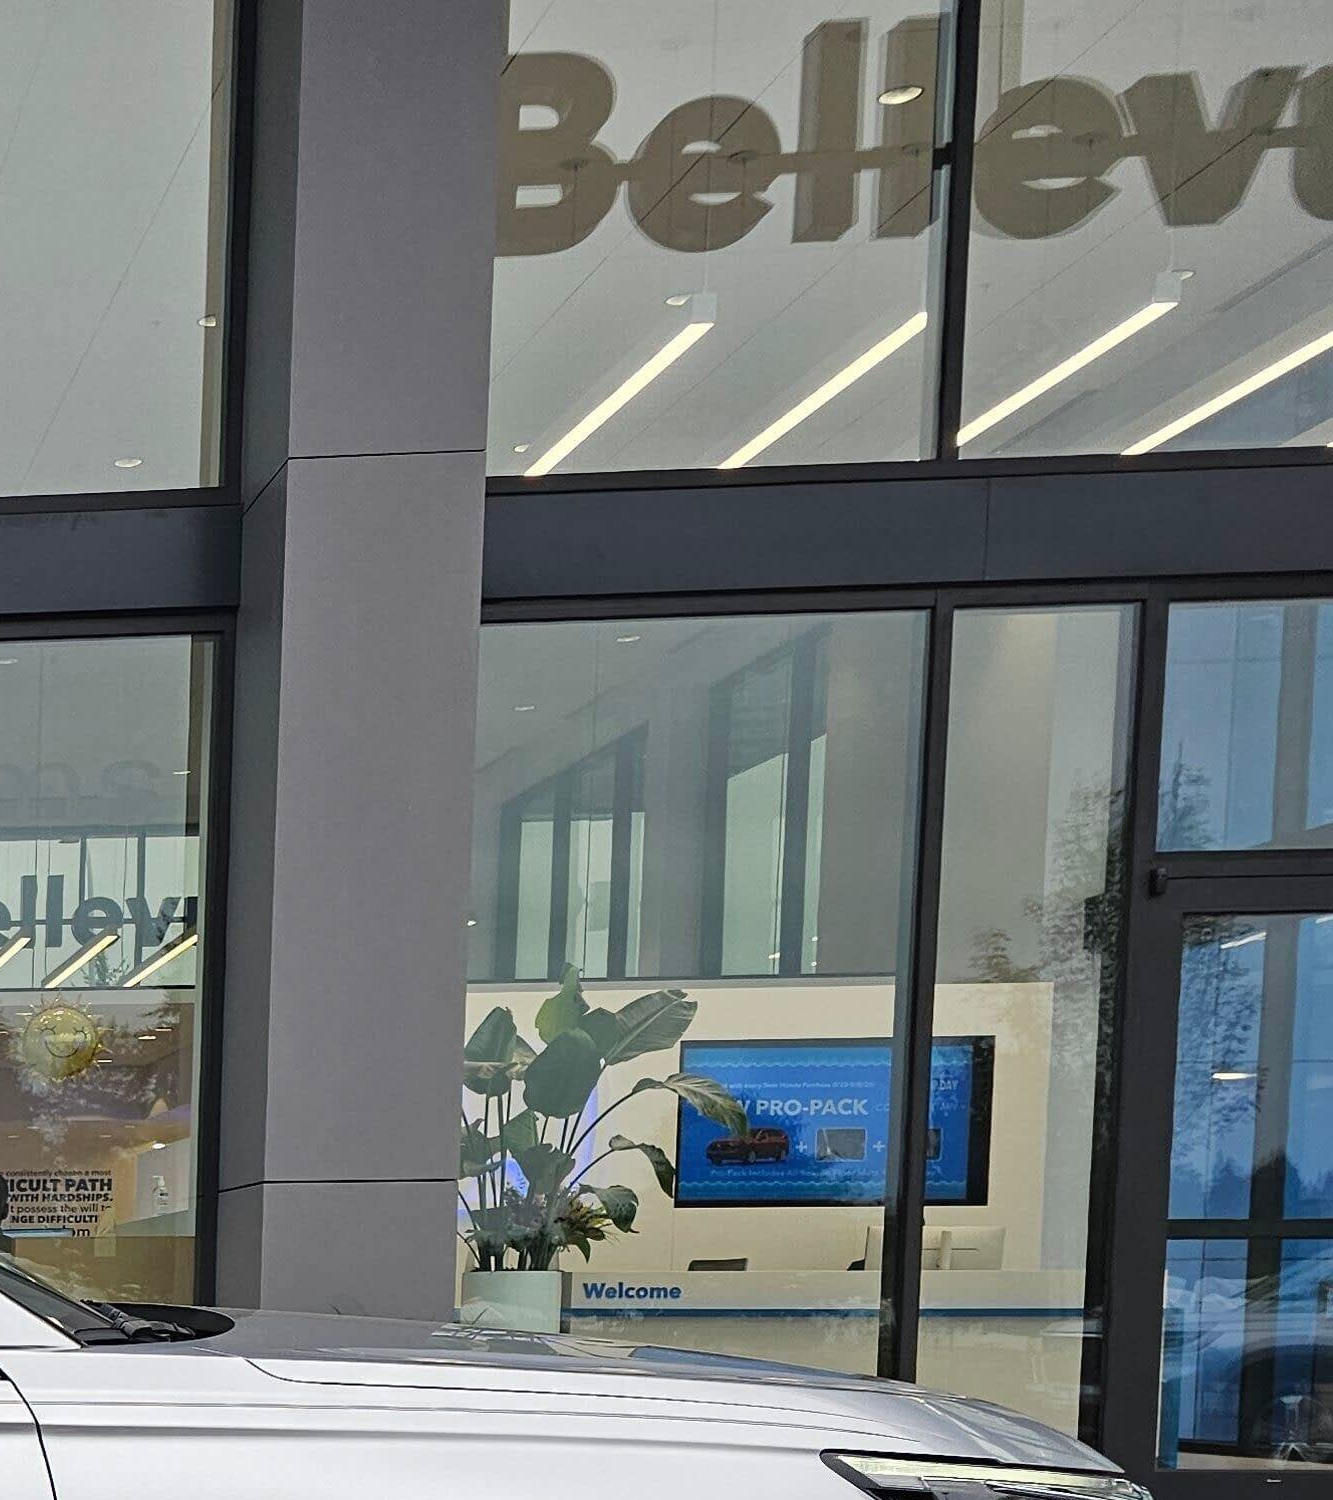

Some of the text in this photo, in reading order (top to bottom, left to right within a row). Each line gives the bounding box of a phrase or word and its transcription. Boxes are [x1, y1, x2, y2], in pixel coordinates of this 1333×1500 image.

[756, 1099, 868, 1116] PRO-PACK
[7, 1179, 113, 1192] ICULT PATH
[42, 1193, 113, 1202] HARDSHIPS.
[17, 1206, 58, 1214] possess
[61, 1204, 77, 1213] the
[80, 1203, 99, 1212] will
[37, 1215, 99, 1224] DIFFICULTI
[582, 1282, 683, 1299] Welcome
